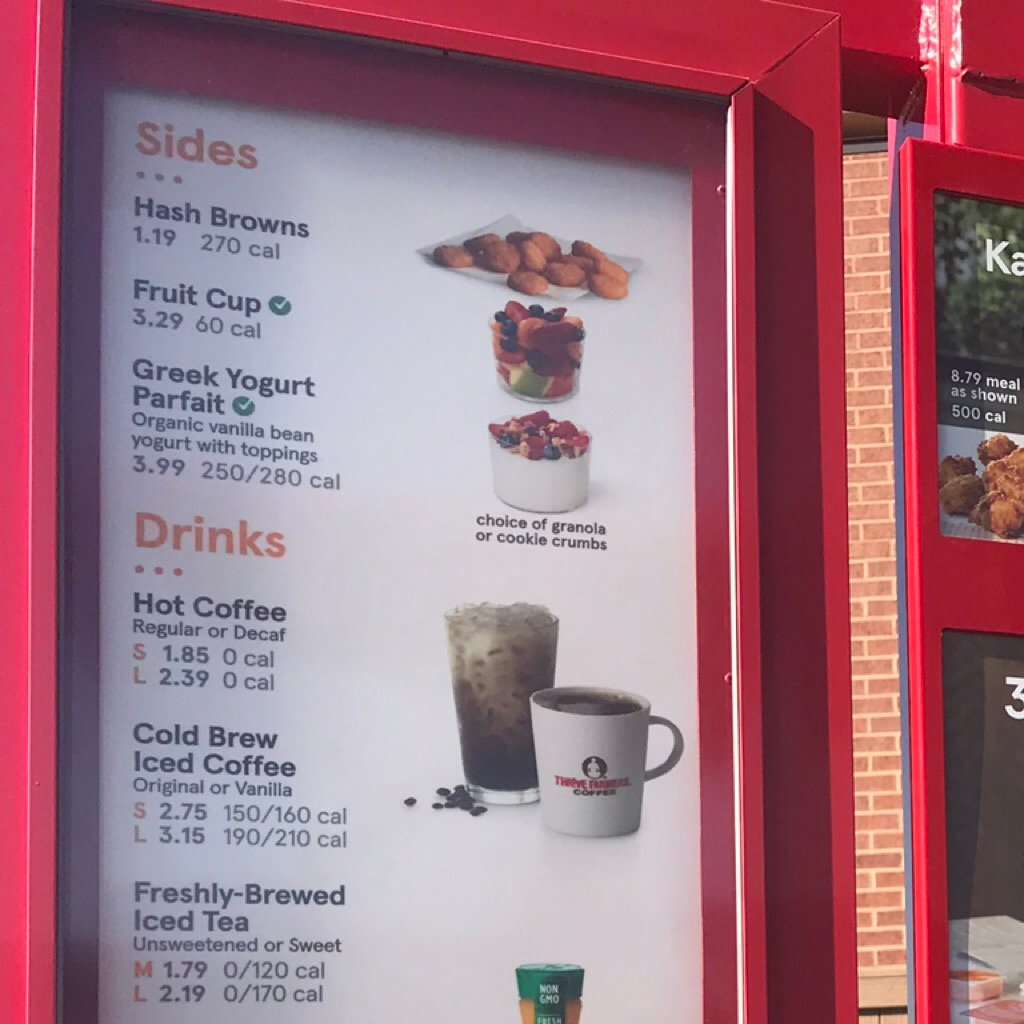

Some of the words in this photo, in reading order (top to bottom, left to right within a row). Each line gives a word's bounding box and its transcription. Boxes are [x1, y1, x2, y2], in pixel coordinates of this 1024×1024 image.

[135, 121, 259, 170] Sides
[135, 196, 200, 224] Hash
[211, 206, 309, 239] Browns
[133, 226, 176, 246] 1.19
[201, 234, 240, 254] 270
[249, 243, 279, 259] cal
[134, 279, 197, 305] Fruit
[206, 288, 261, 317] Cup
[133, 308, 183, 329] 3.29
[196, 316, 223, 334] 60
[231, 323, 260, 339] cal
[133, 359, 219, 387] Greek
[225, 368, 315, 397] Yogurt
[952, 370, 981, 385] 8.79
[987, 377, 1020, 390] meal
[132, 385, 224, 416] Parfait
[951, 387, 966, 397] as
[972, 388, 1016, 404] shown
[132, 412, 203, 432] Organic
[209, 422, 264, 437] vanilla
[271, 425, 313, 443] bean
[952, 405, 980, 420] 500
[985, 411, 1005, 423] cal
[131, 435, 191, 452] yogurt
[196, 439, 235, 455] with
[241, 442, 317, 465] toppings
[133, 455, 185, 476] 3.99
[201, 461, 301, 489] 250/280
[310, 474, 340, 490] cal
[135, 512, 287, 559] Drinks
[477, 514, 527, 528] choice
[532, 519, 547, 530] of
[552, 522, 606, 535] granola
[476, 532, 492, 541] or
[497, 532, 547, 545] cookie
[552, 537, 607, 550] crumbs
[134, 592, 184, 616] Hot
[193, 597, 286, 621] Coffee
[133, 643, 146, 660] S
[163, 645, 209, 663] 1.85
[223, 648, 236, 665] 0
[244, 651, 273, 667] cal
[133, 723, 198, 745] Cold
[209, 726, 277, 748] Brew
[135, 751, 193, 773] Iced
[204, 753, 296, 777] Coffee
[133, 777, 204, 796] Original
[210, 784, 230, 795] or
[235, 781, 292, 796] Vanilla
[540, 984, 559, 994] NON
[540, 995, 559, 1005] GMO
